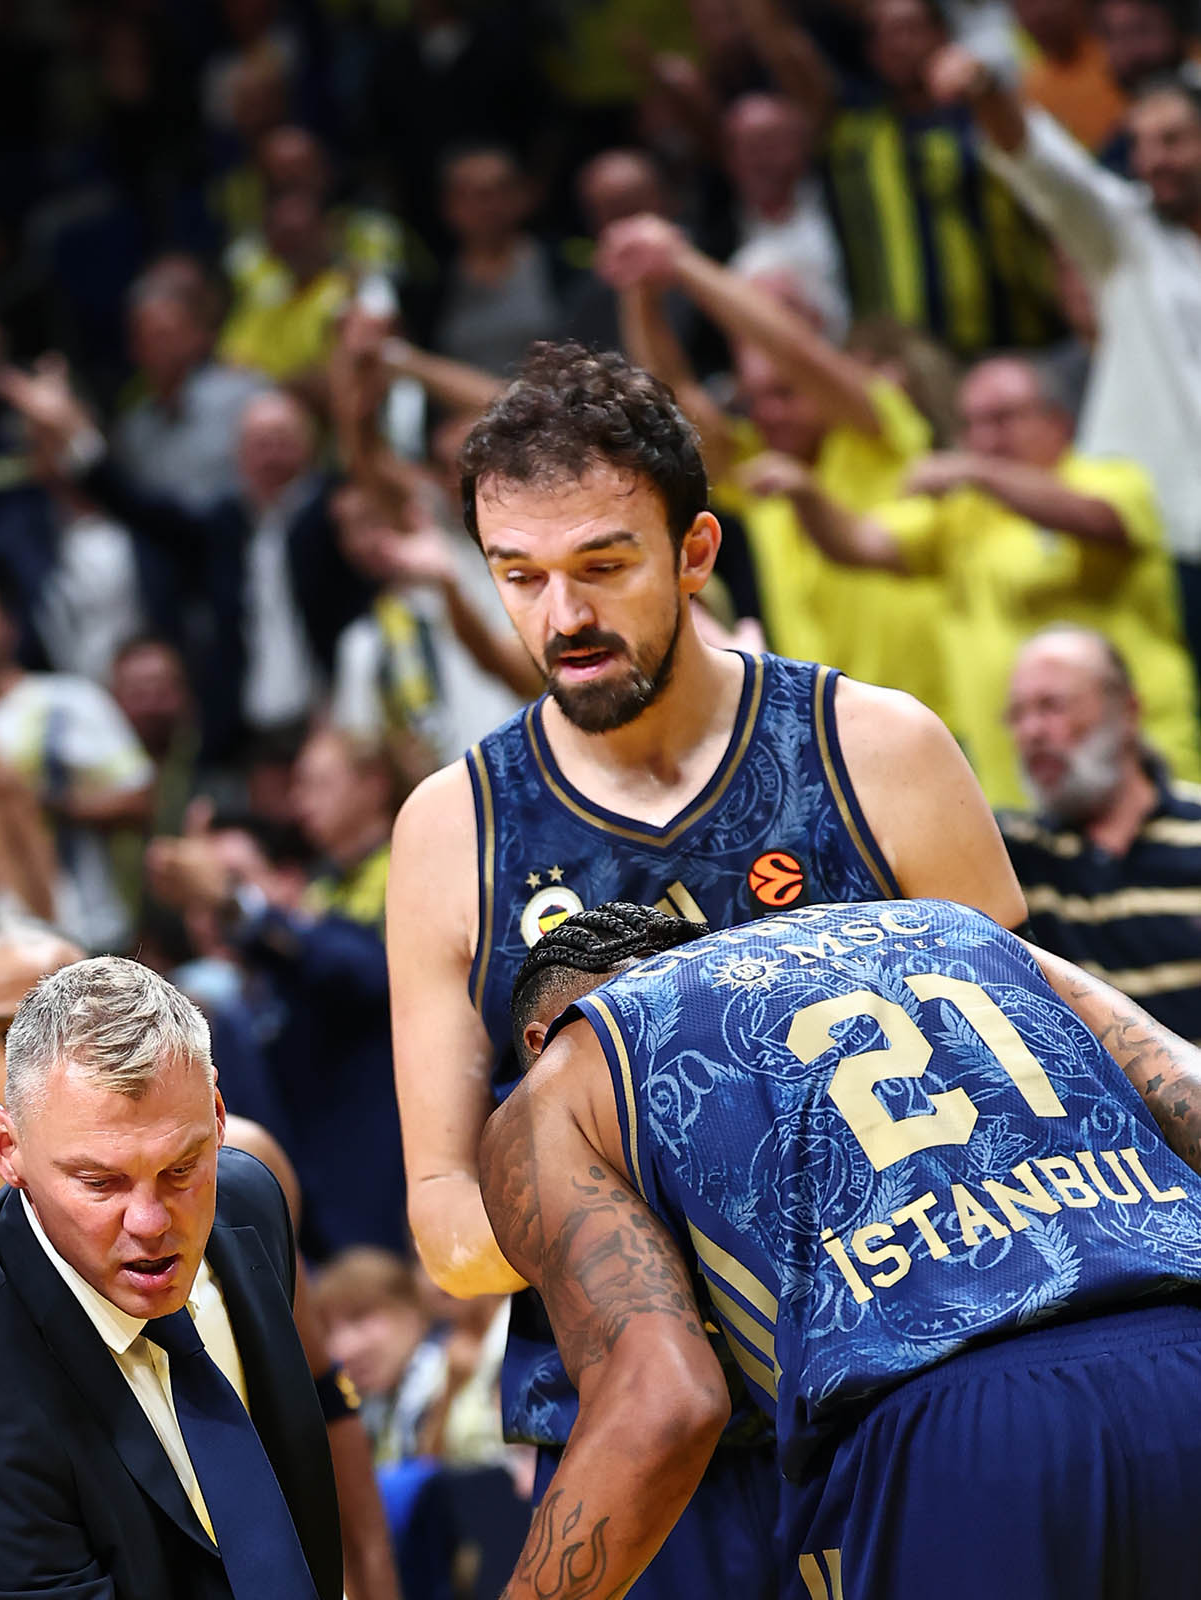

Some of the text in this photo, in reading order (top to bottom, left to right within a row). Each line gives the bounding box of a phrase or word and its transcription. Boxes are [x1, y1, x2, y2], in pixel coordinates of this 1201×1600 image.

[776, 910, 929, 965] MSC
[810, 938, 947, 976] CRUISES
[786, 972, 1069, 1172] 21
[821, 1149, 1188, 1304] İSTANBUL
